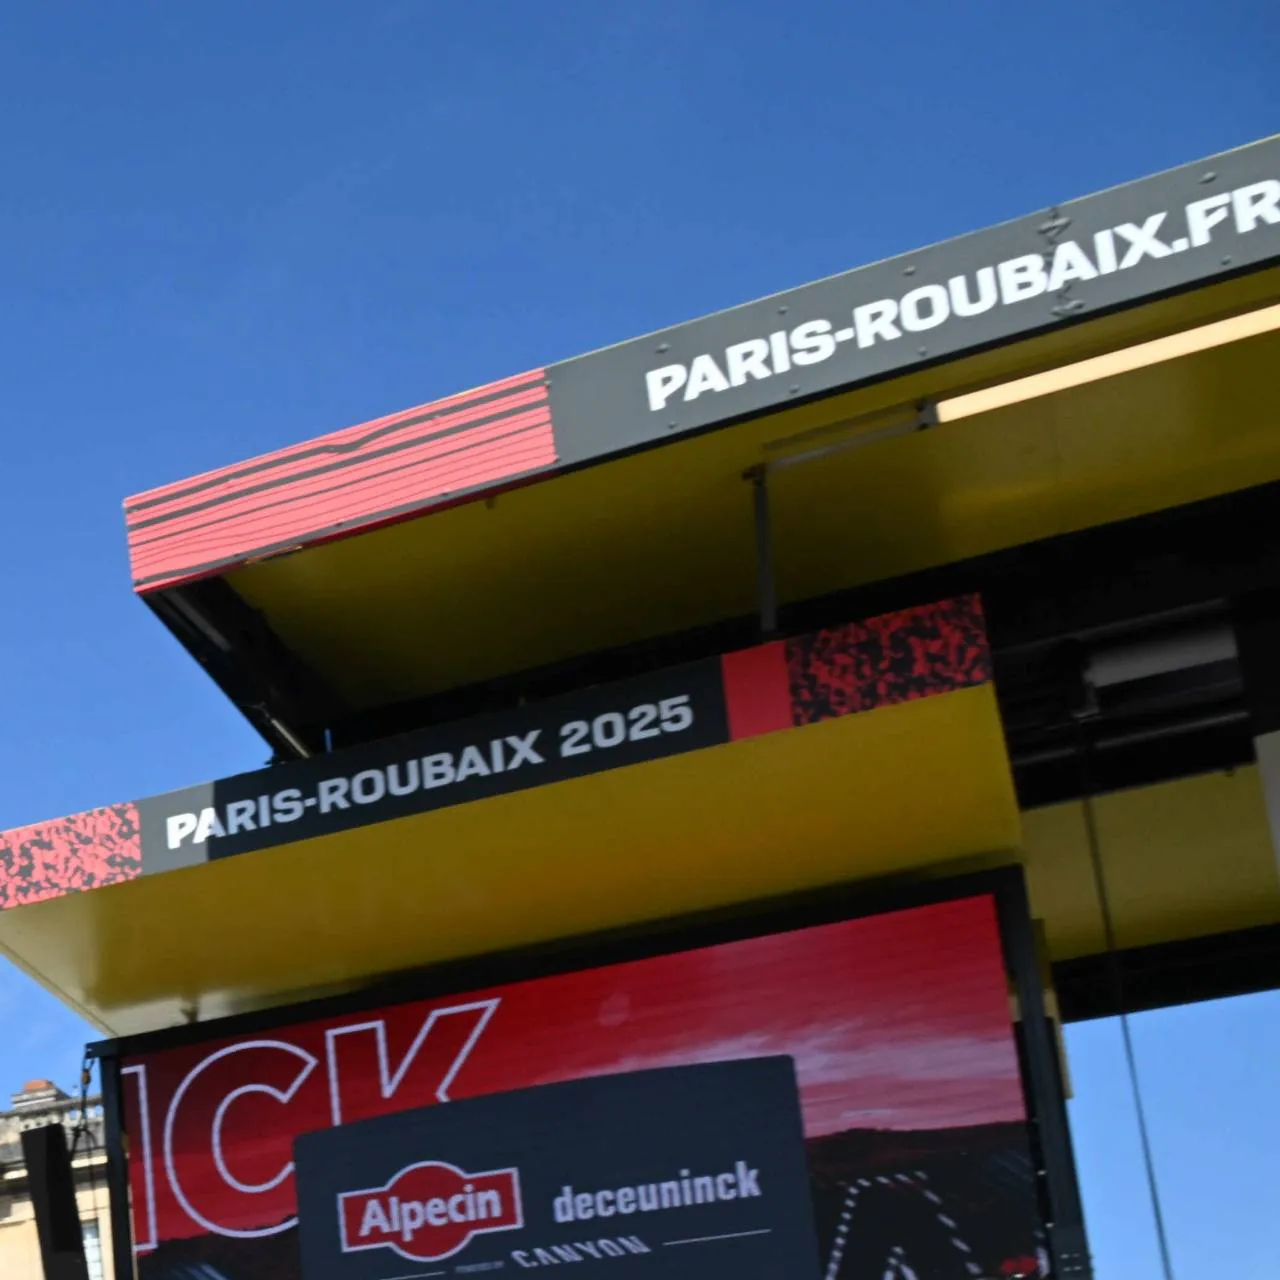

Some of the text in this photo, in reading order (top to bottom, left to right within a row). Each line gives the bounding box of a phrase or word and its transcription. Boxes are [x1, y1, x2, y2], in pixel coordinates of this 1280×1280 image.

[646, 178, 1280, 411] PARIS-ROUBAIX.FR
[165, 695, 694, 850] PARIS-ROUBAIX 2025
[359, 1183, 502, 1241] Alpecin
[553, 1161, 761, 1223] deceuninck
[510, 1235, 652, 1268] CANYON
